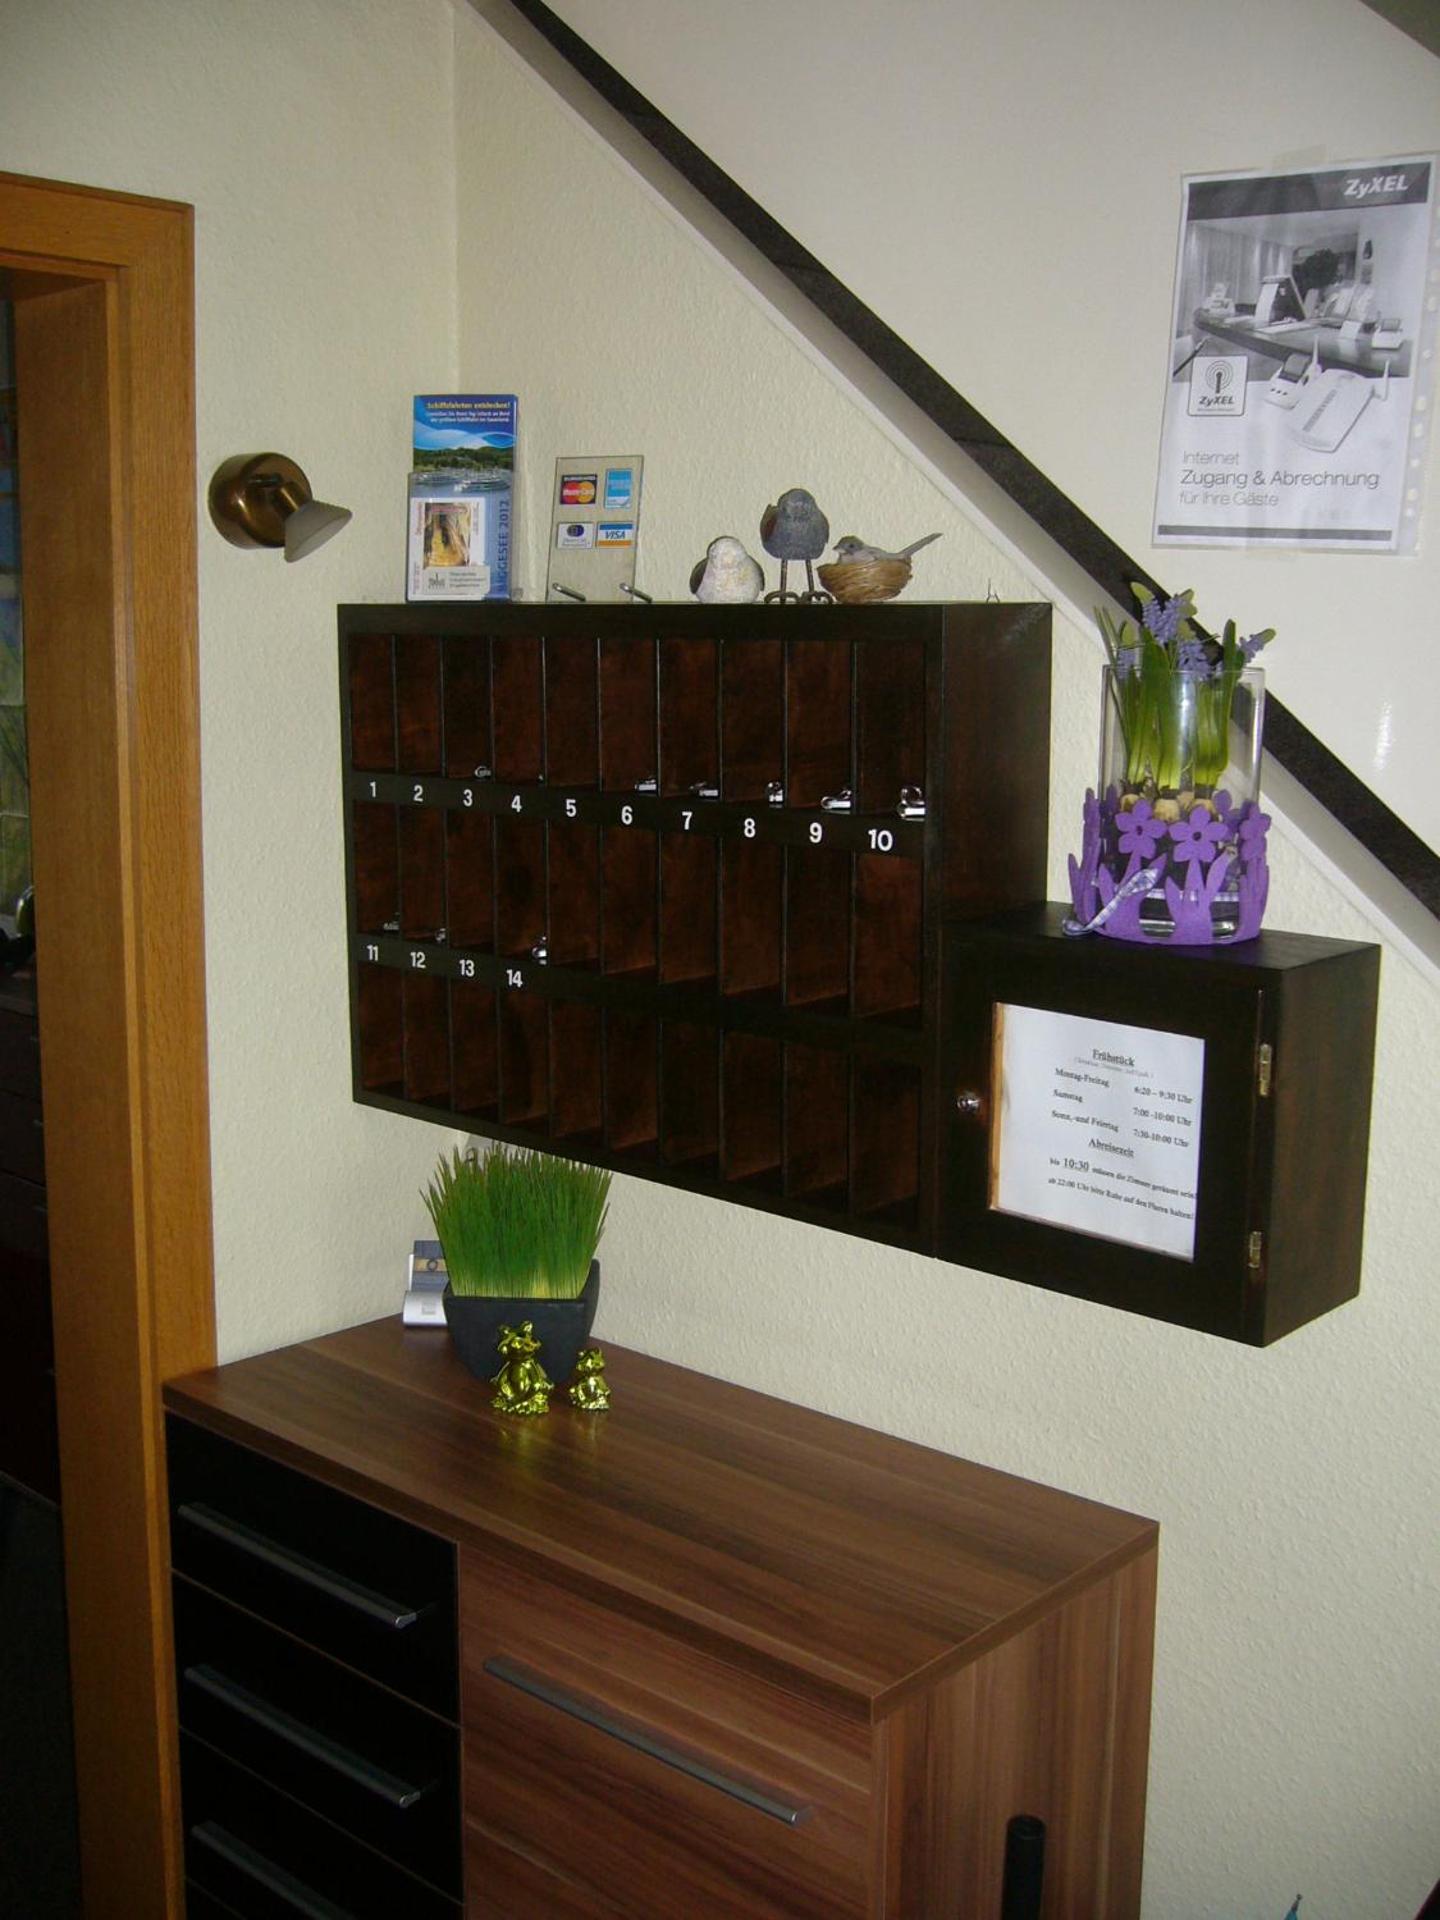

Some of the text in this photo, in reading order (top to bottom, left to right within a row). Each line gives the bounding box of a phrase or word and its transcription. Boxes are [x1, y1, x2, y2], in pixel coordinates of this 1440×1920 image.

[1343, 173, 1410, 198] ZyXEL
[1198, 395, 1235, 407] ZyXEL
[1182, 450, 1240, 465] Internet
[1180, 469, 1380, 489] Zugang & Abrechnung
[1179, 491, 1279, 506] für Ihre Gäste
[605, 530, 626, 540] VISA
[369, 781, 377, 798] 1
[413, 784, 424, 802] 2
[463, 788, 473, 807] 3
[511, 795, 522, 813] 4
[566, 798, 577, 818] 5
[621, 805, 633, 825] 6
[681, 811, 693, 830] 7
[743, 817, 756, 838] 8
[809, 822, 823, 844] 9
[867, 828, 893, 852] 10
[367, 944, 379, 962] 11
[410, 951, 426, 969] 12
[459, 959, 475, 977] 13
[506, 969, 523, 988] 14
[1092, 1048, 1135, 1067] Frühstück
[1177, 1092, 1193, 1104] Uhr
[1053, 1088, 1083, 1103] Samstag
[1176, 1115, 1192, 1127] Uhr
[1088, 1138, 1135, 1158] Abreisezeit
[1173, 1137, 1189, 1148] Uhr
[1063, 1157, 1090, 1172] 10:30
